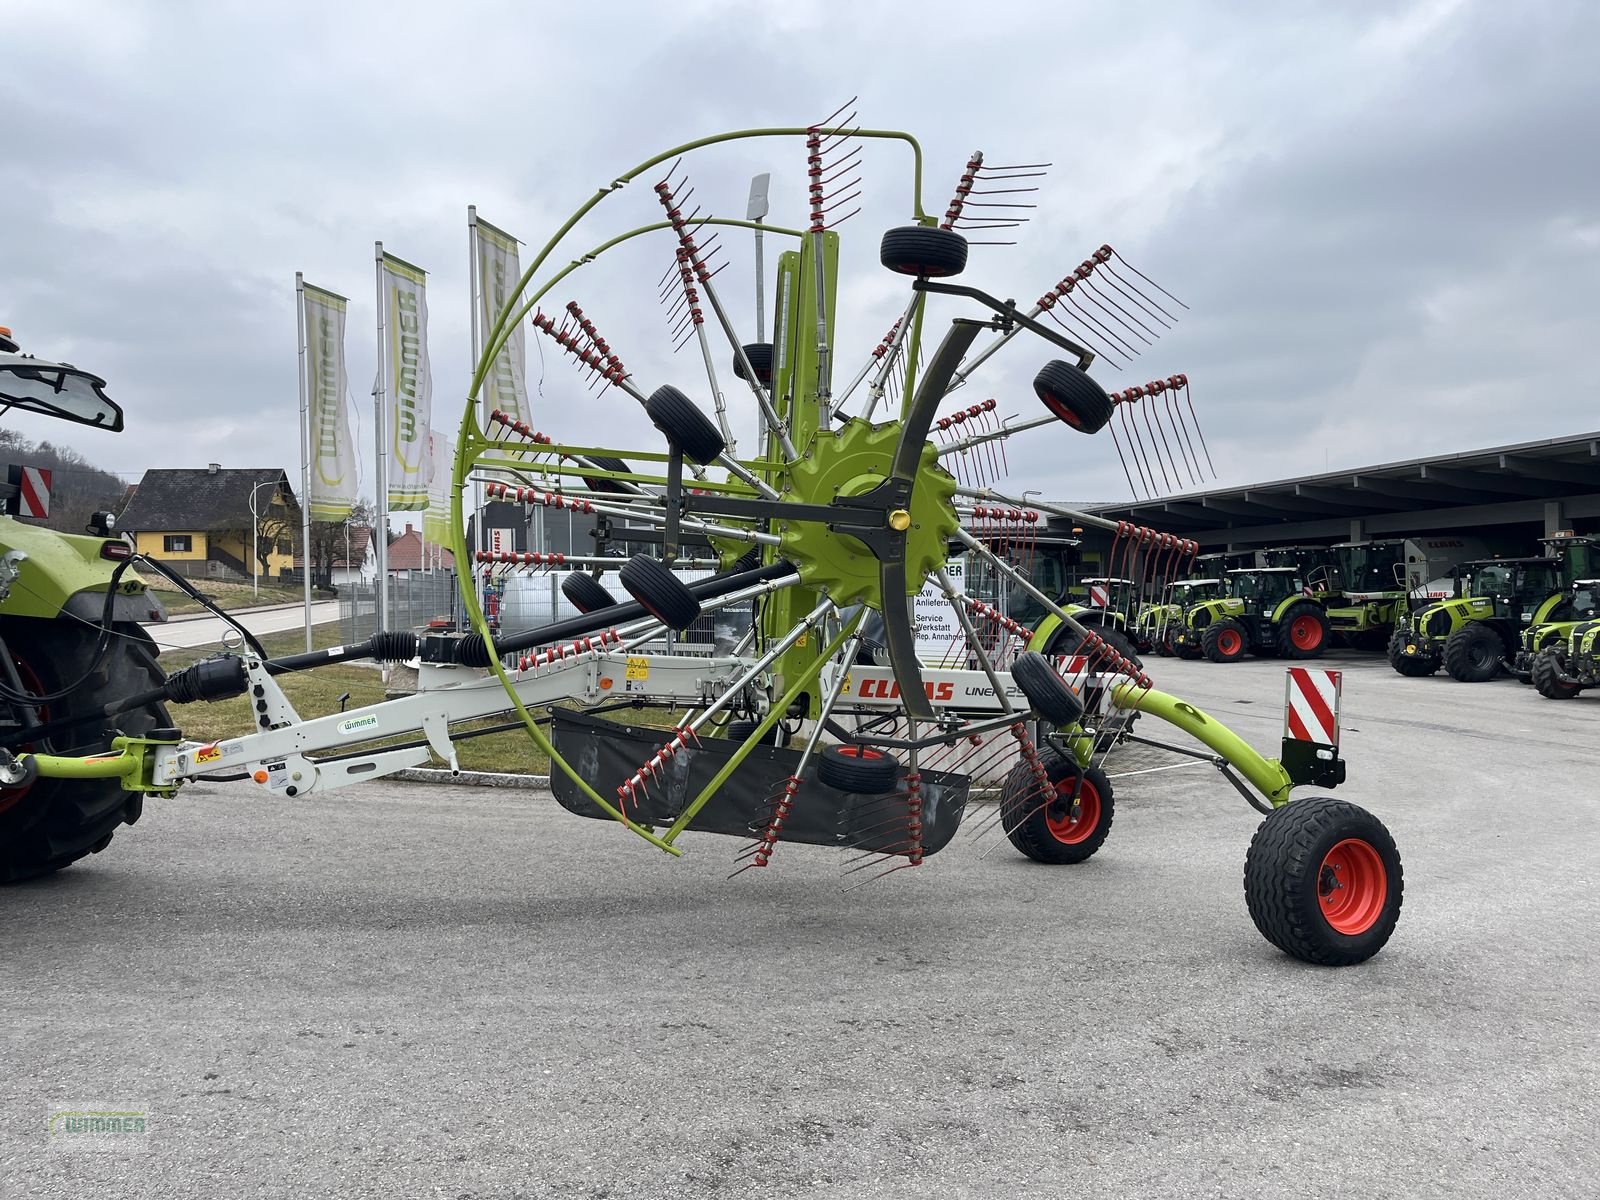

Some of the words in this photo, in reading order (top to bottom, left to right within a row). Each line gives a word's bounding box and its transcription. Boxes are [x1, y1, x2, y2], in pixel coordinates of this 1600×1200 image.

[398, 289, 419, 443] WIMMER
[1427, 541, 1465, 549] CLAAS
[917, 589, 933, 597] KW
[915, 613, 943, 622] Service
[915, 623, 951, 631] Werkstatt
[916, 632, 930, 641] Rep.
[344, 717, 377, 730] WIMMER
